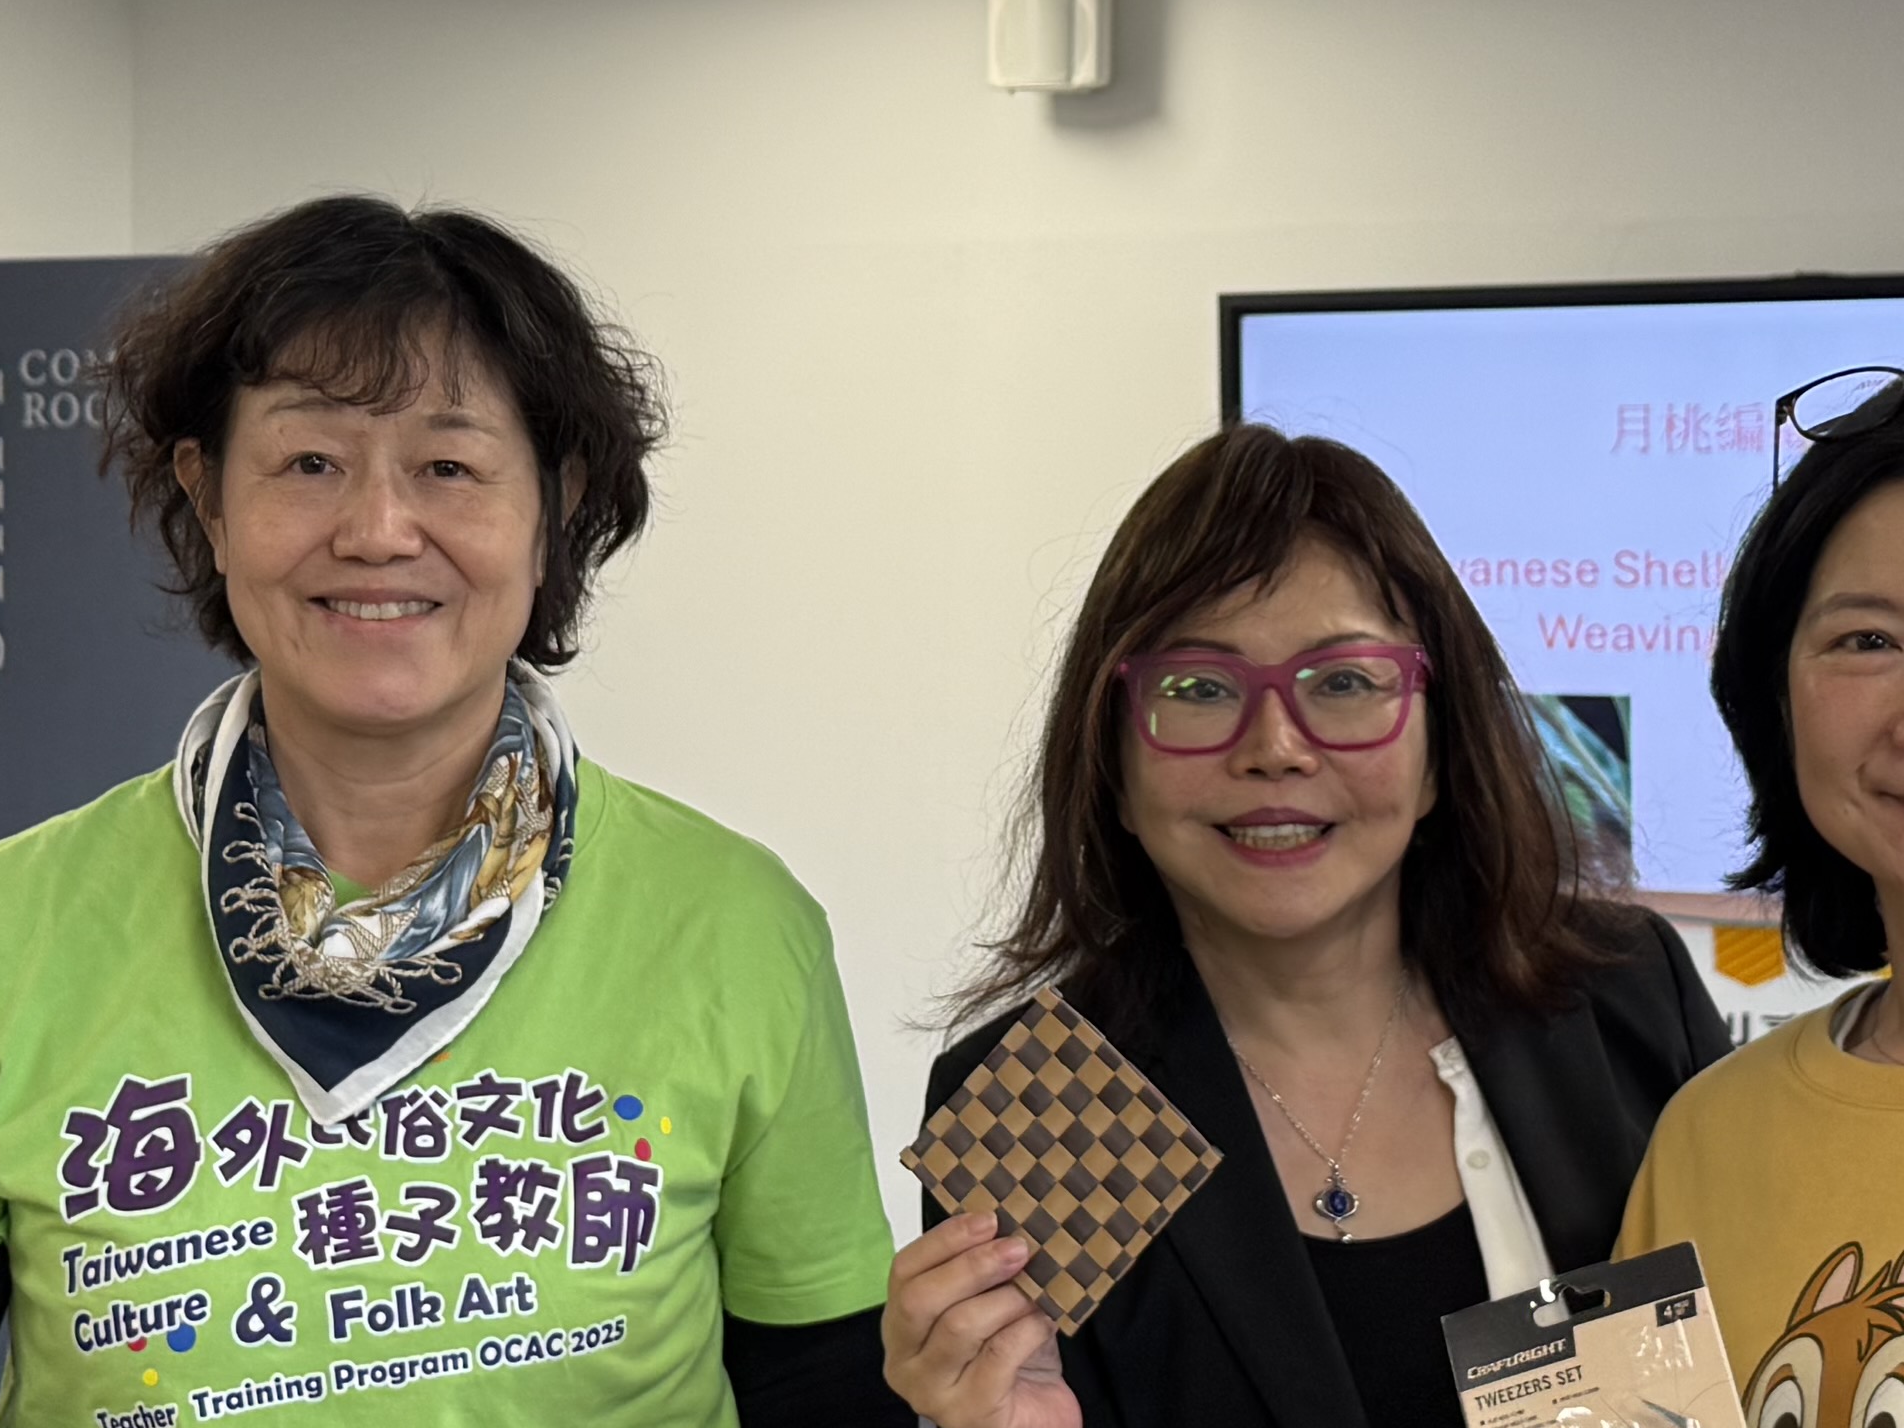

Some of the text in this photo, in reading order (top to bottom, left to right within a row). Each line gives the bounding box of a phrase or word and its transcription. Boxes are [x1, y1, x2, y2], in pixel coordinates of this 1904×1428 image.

[295, 1156, 662, 1273] 種子教師
[63, 1220, 274, 1294] Taiwanese
[73, 1275, 535, 1352] Culture & Folk Art
[191, 1374, 324, 1419] Training
[333, 1348, 470, 1392] Program
[479, 1332, 564, 1367] OCAC
[570, 1318, 626, 1355] 2025
[1474, 1365, 1584, 1411] TWEEZERS SET
